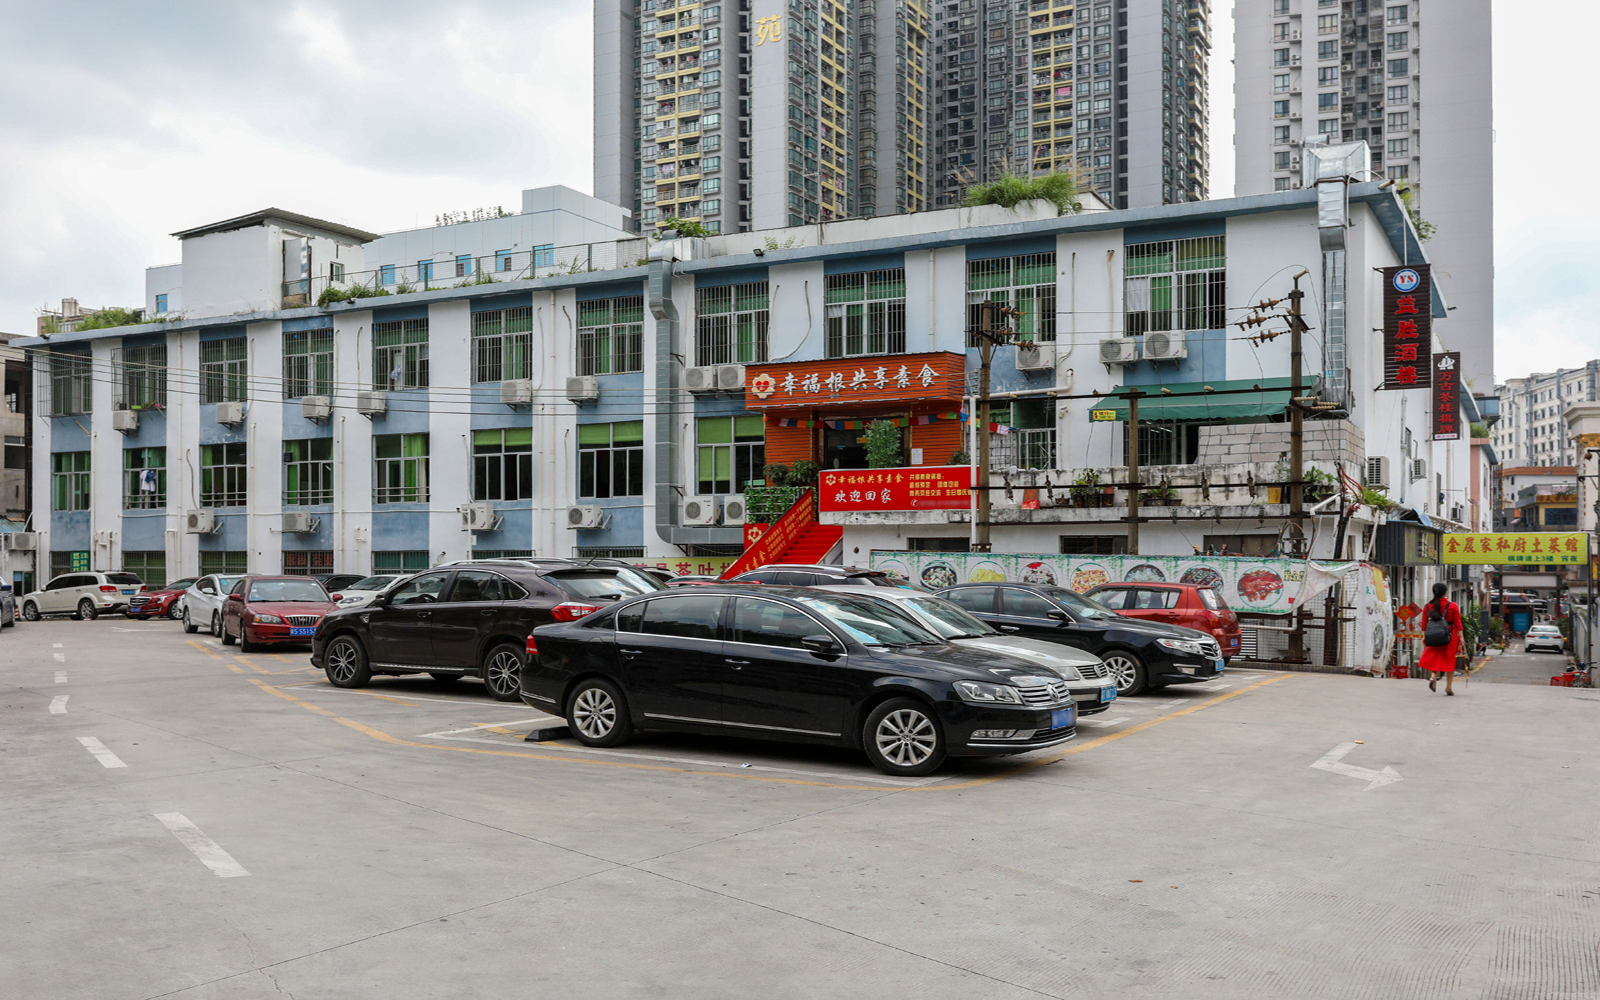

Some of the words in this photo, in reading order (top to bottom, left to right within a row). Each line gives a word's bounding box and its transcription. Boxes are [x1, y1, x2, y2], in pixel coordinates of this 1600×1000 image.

[755, 14, 782, 46] 苑
[1399, 274, 1414, 284] YS
[1394, 295, 1419, 384] 益胜酒楼
[779, 363, 940, 396] 幸福根共享素食
[1437, 371, 1455, 433] 万古茶楼棋牌
[837, 473, 904, 485] 幸福根共享素食
[834, 488, 892, 504] 欢迎回家
